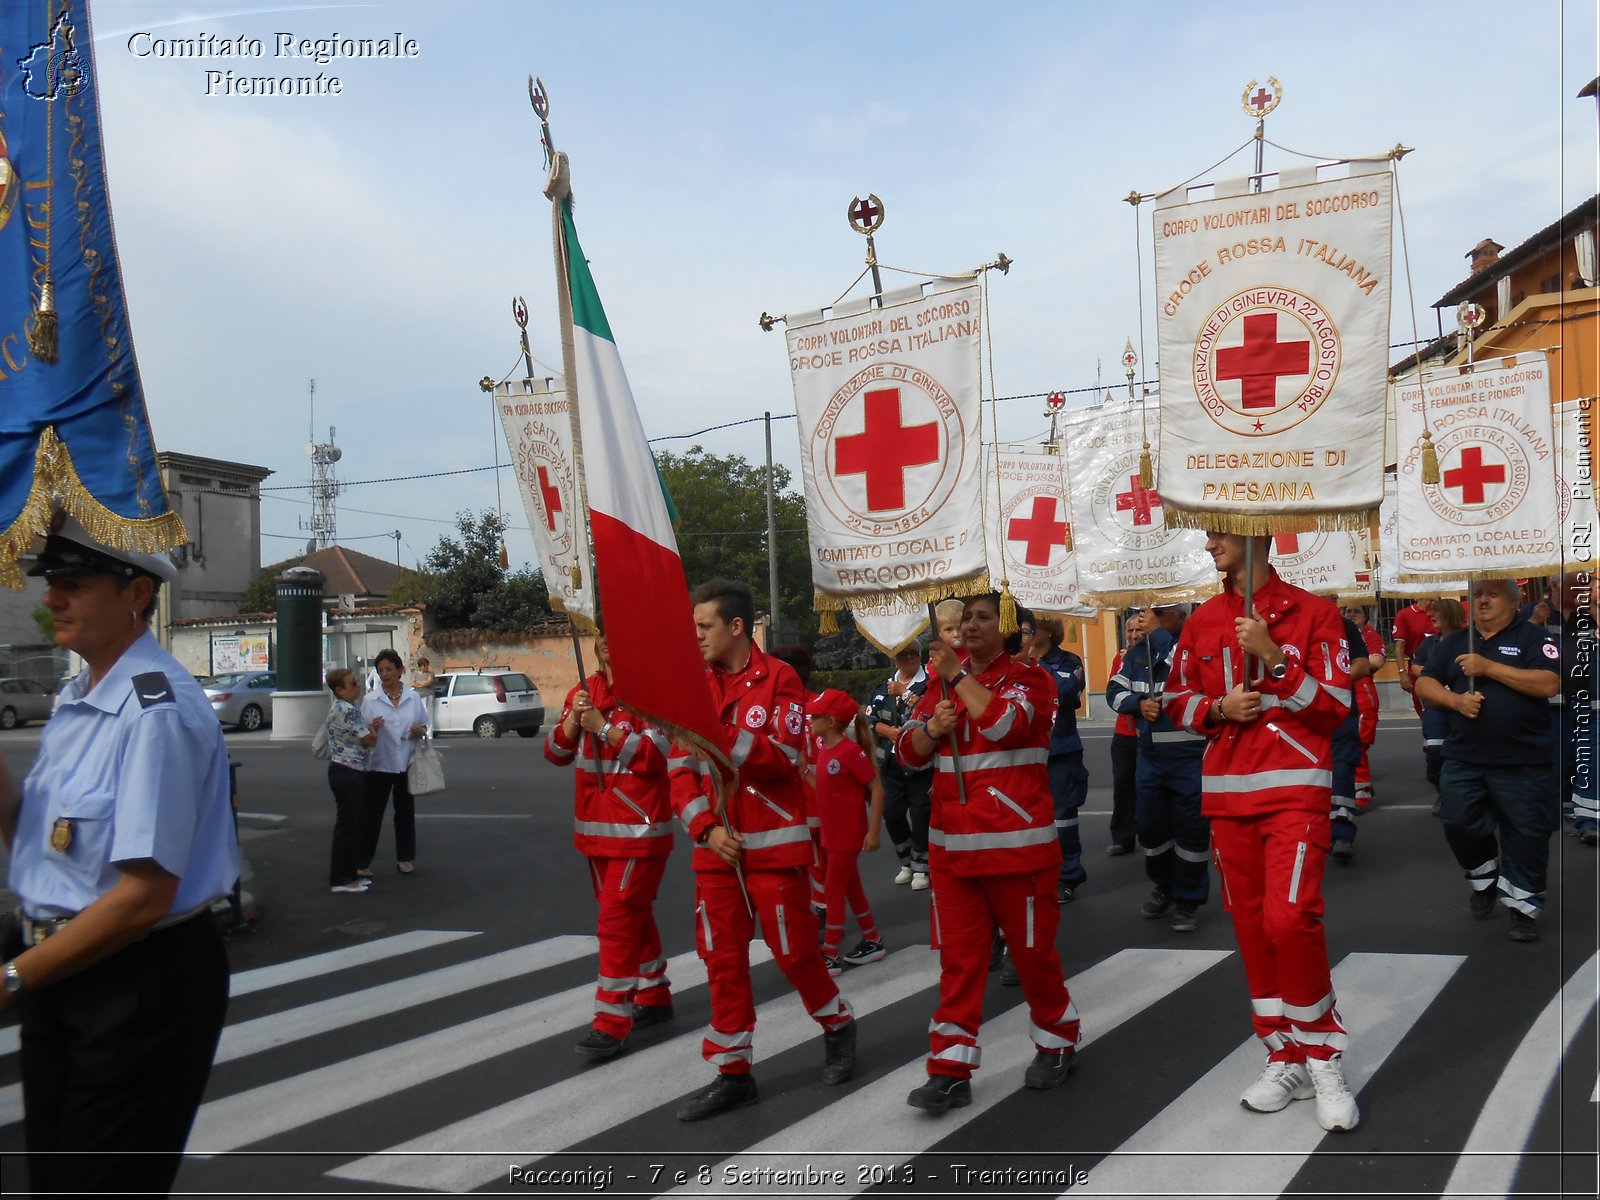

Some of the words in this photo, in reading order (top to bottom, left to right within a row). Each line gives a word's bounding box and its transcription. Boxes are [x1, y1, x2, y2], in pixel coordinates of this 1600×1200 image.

[1163, 218, 1198, 237] CORPO
[1203, 207, 1270, 230] VOLONTARI
[1276, 203, 1300, 221] DEL
[1305, 190, 1379, 217] SOCCORSO
[1163, 260, 1213, 317] CROCE
[1217, 236, 1287, 264] ROSSA
[1297, 238, 1378, 296] ITALIANA
[1217, 306, 1232, 323] DI
[1232, 291, 1297, 312] GINEVRA
[1298, 302, 1318, 320] 22
[798, 335, 827, 351] CORPO
[830, 320, 883, 345] VOLONTARI
[890, 316, 912, 333] DEL
[917, 299, 970, 327] SOCCORSO
[791, 350, 843, 371] CROCE
[848, 338, 903, 363] ROSSA
[909, 318, 980, 351] ITALIANA
[1312, 318, 1336, 381] AGOSTO
[1196, 320, 1225, 417] CONVENZIONE
[1428, 381, 1473, 397] VOLONTARI
[1478, 377, 1495, 389] DEL
[1499, 369, 1543, 386] SOCCORSO
[816, 366, 884, 440] CONVENZIONE
[891, 366, 908, 379] DI
[911, 371, 955, 420] GINEVRA
[1298, 384, 1325, 413] 1864
[1430, 393, 1477, 409] FEMMINILE
[1479, 392, 1486, 402] E
[1488, 386, 1525, 401] PIONIERI
[1433, 406, 1488, 432] ROSSA
[1492, 408, 1549, 461] ITALIANA
[1451, 428, 1506, 445] GINEVRA
[1187, 450, 1314, 470] DELEGAZIONE
[1325, 449, 1346, 467] DI
[1436, 442, 1450, 454] DI
[1505, 442, 1520, 455] 22
[1019, 461, 1054, 472] VOLONTARI
[1511, 459, 1526, 500] AGOSTO
[1202, 481, 1314, 501] PAESANA
[844, 506, 930, 535] 22-8-1864
[817, 545, 882, 562] COMITATO
[888, 536, 955, 558] LOCALE
[1402, 549, 1451, 561] BORGO
[1456, 547, 1468, 559] S.
[1473, 541, 1555, 557] DALMAZZO
[1410, 534, 1472, 548] COMITATO
[1476, 529, 1529, 542] LOCALE
[1533, 529, 1546, 539] DI
[837, 558, 952, 586] RACCONIGI
[1089, 559, 1143, 573] COMITATO
